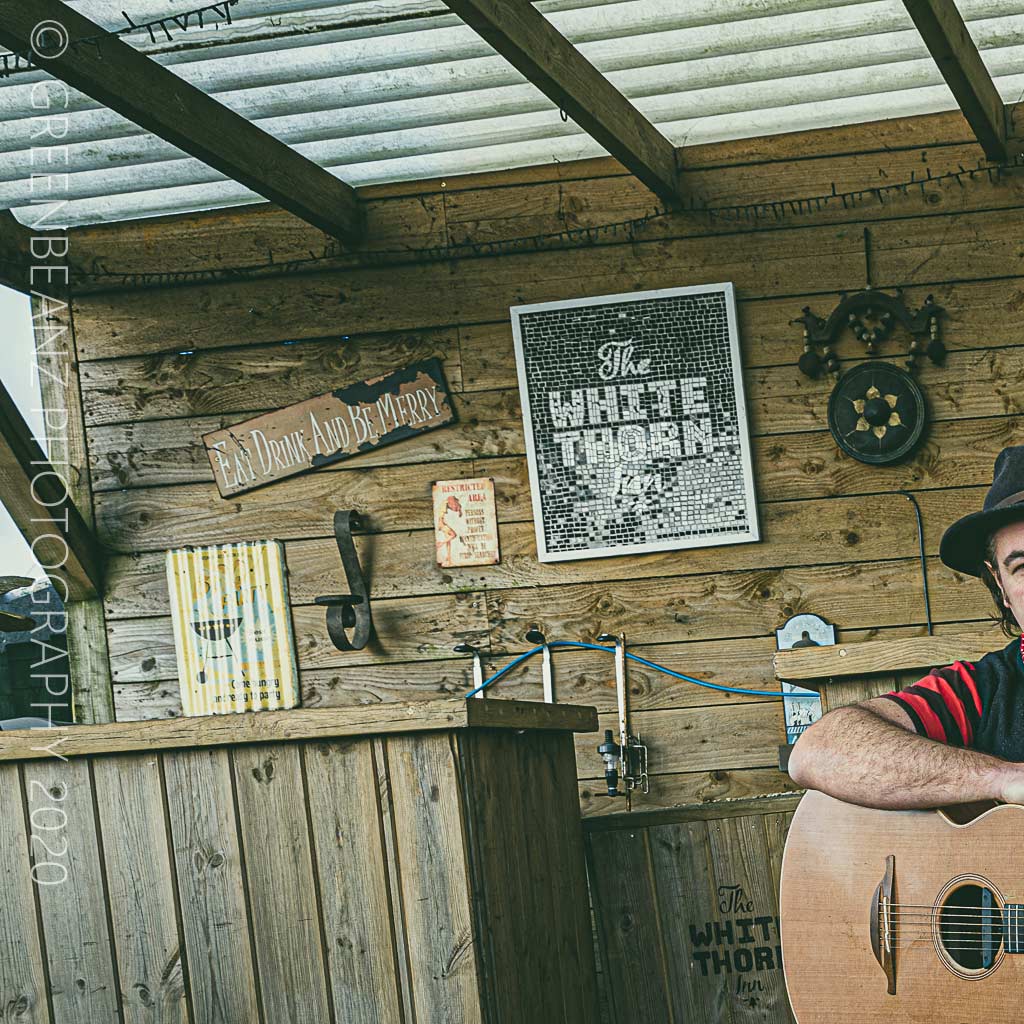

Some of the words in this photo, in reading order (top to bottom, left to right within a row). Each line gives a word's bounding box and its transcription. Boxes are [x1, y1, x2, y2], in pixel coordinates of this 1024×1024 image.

[598, 337, 651, 380] The
[549, 377, 710, 427] WHITE
[553, 417, 714, 467] THORN
[718, 884, 754, 913] The
[736, 975, 765, 995] Inn
